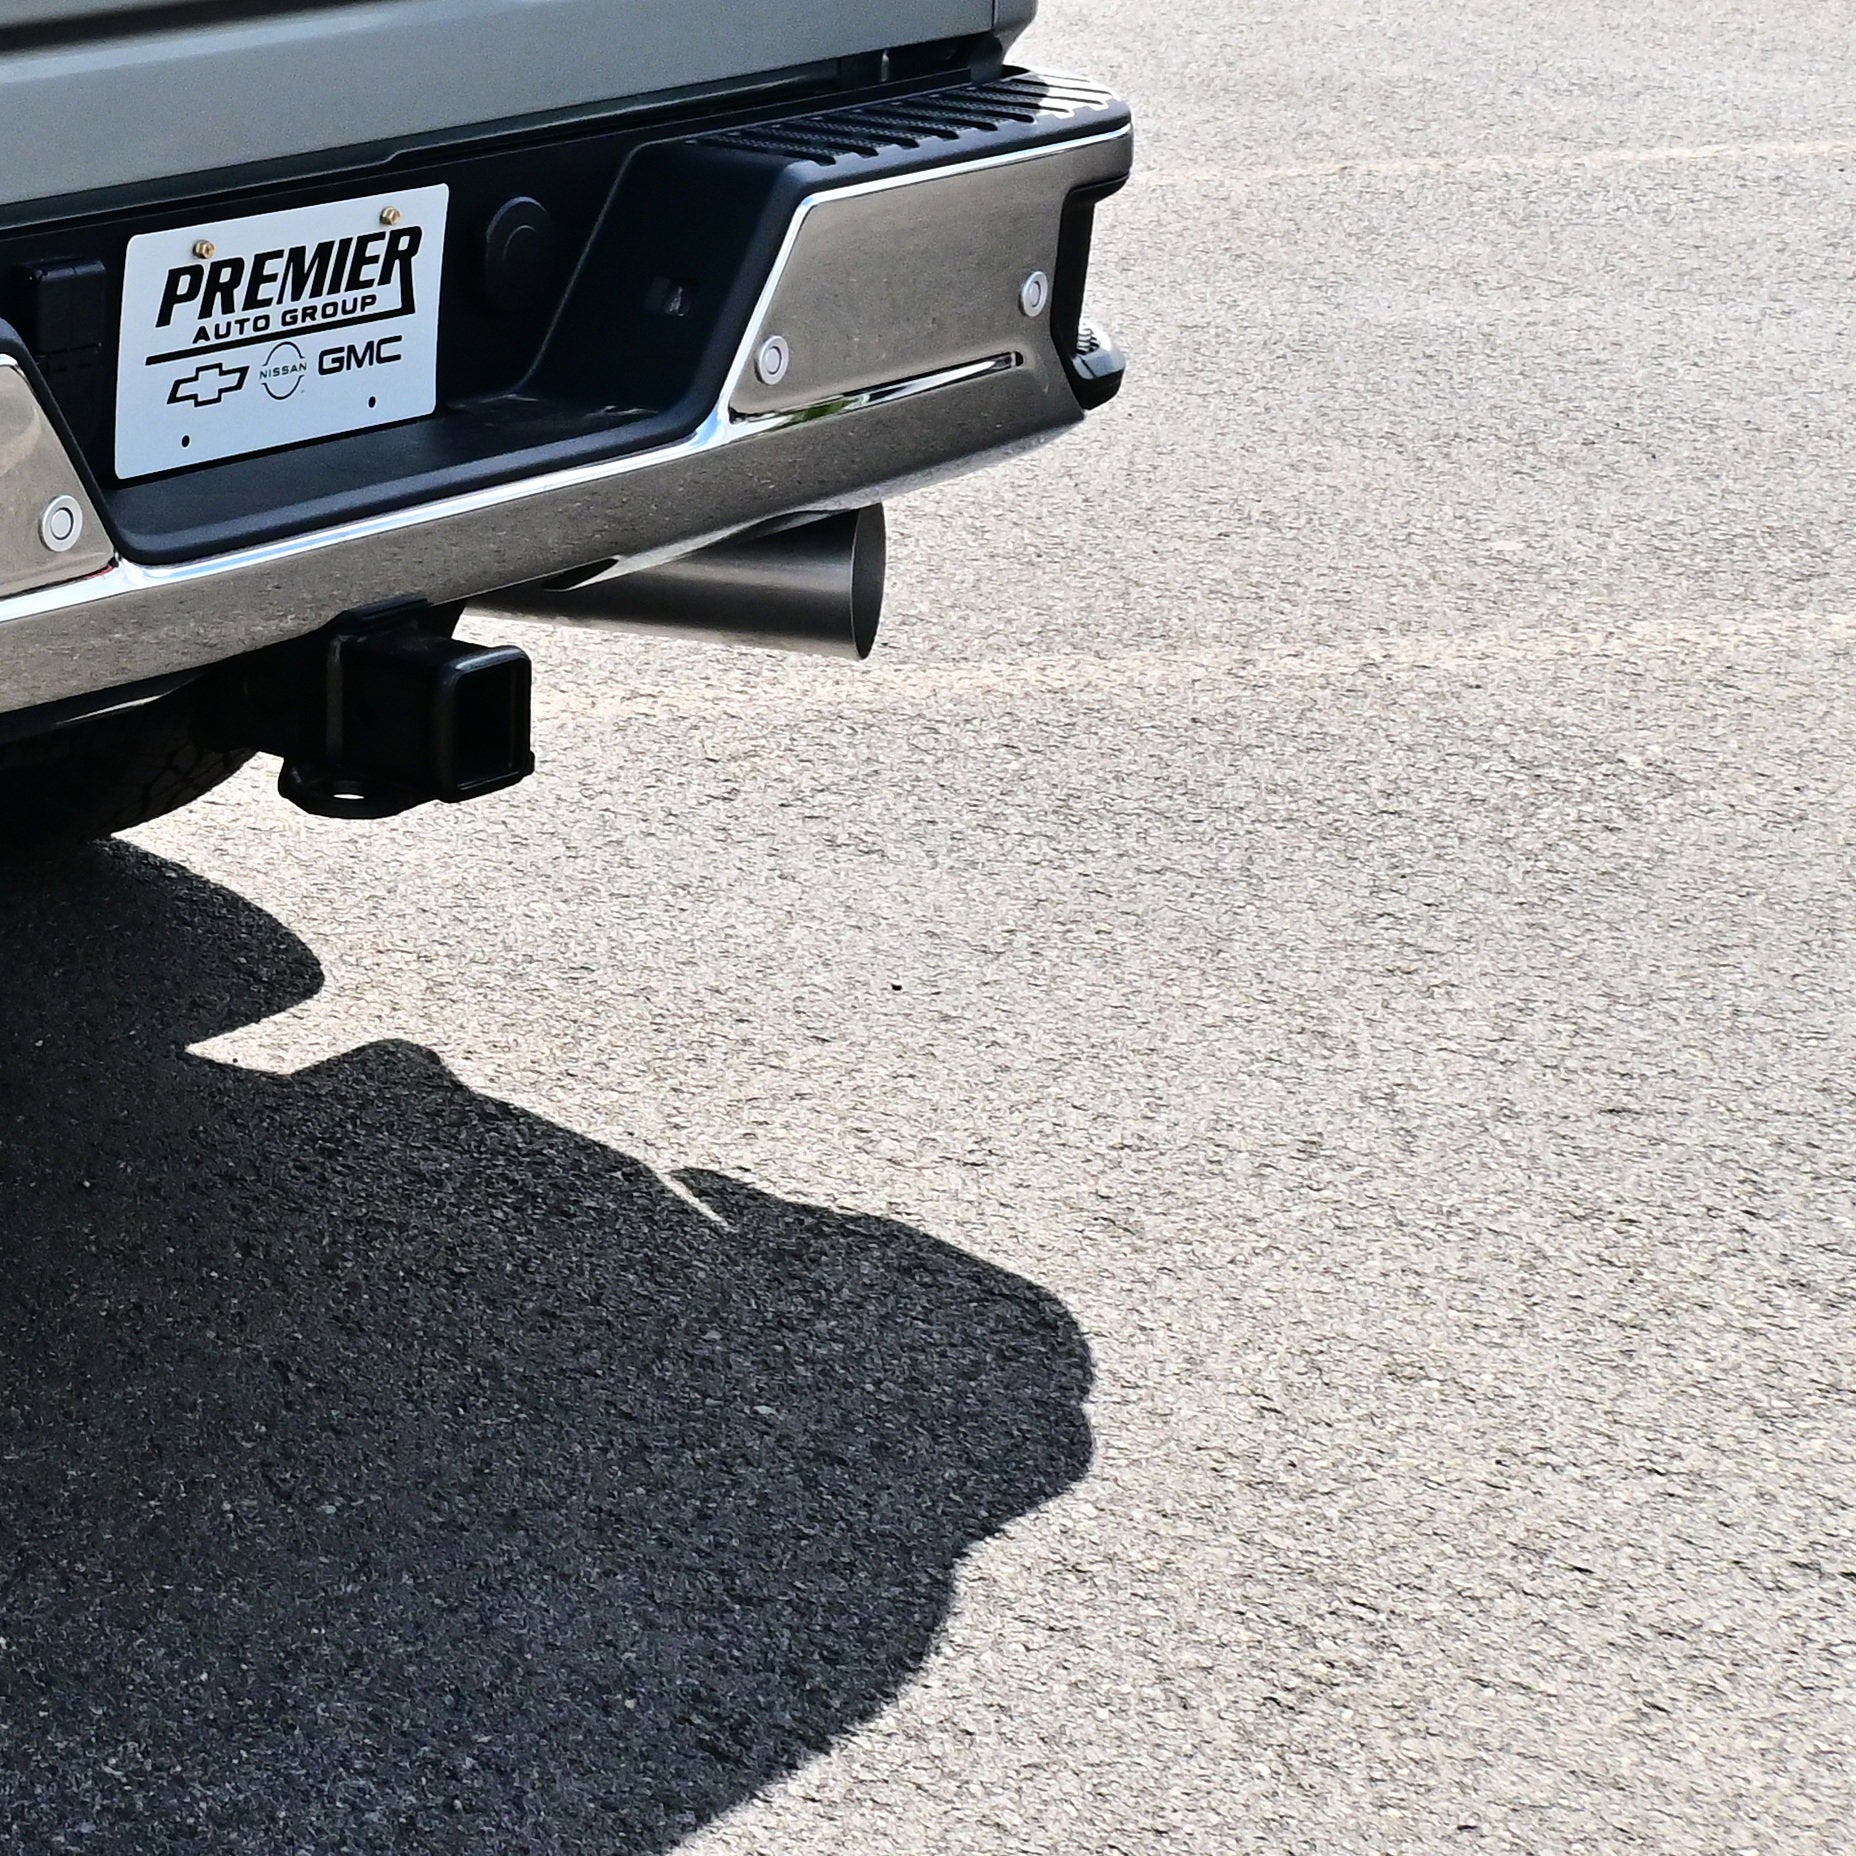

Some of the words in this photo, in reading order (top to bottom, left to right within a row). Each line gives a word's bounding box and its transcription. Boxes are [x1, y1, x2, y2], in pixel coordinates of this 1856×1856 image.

[155, 225, 423, 328] PREMIER
[192, 314, 271, 344] AUTO
[280, 293, 377, 327] GROUP
[259, 361, 308, 381] NISSAN
[317, 334, 403, 376] GMC
